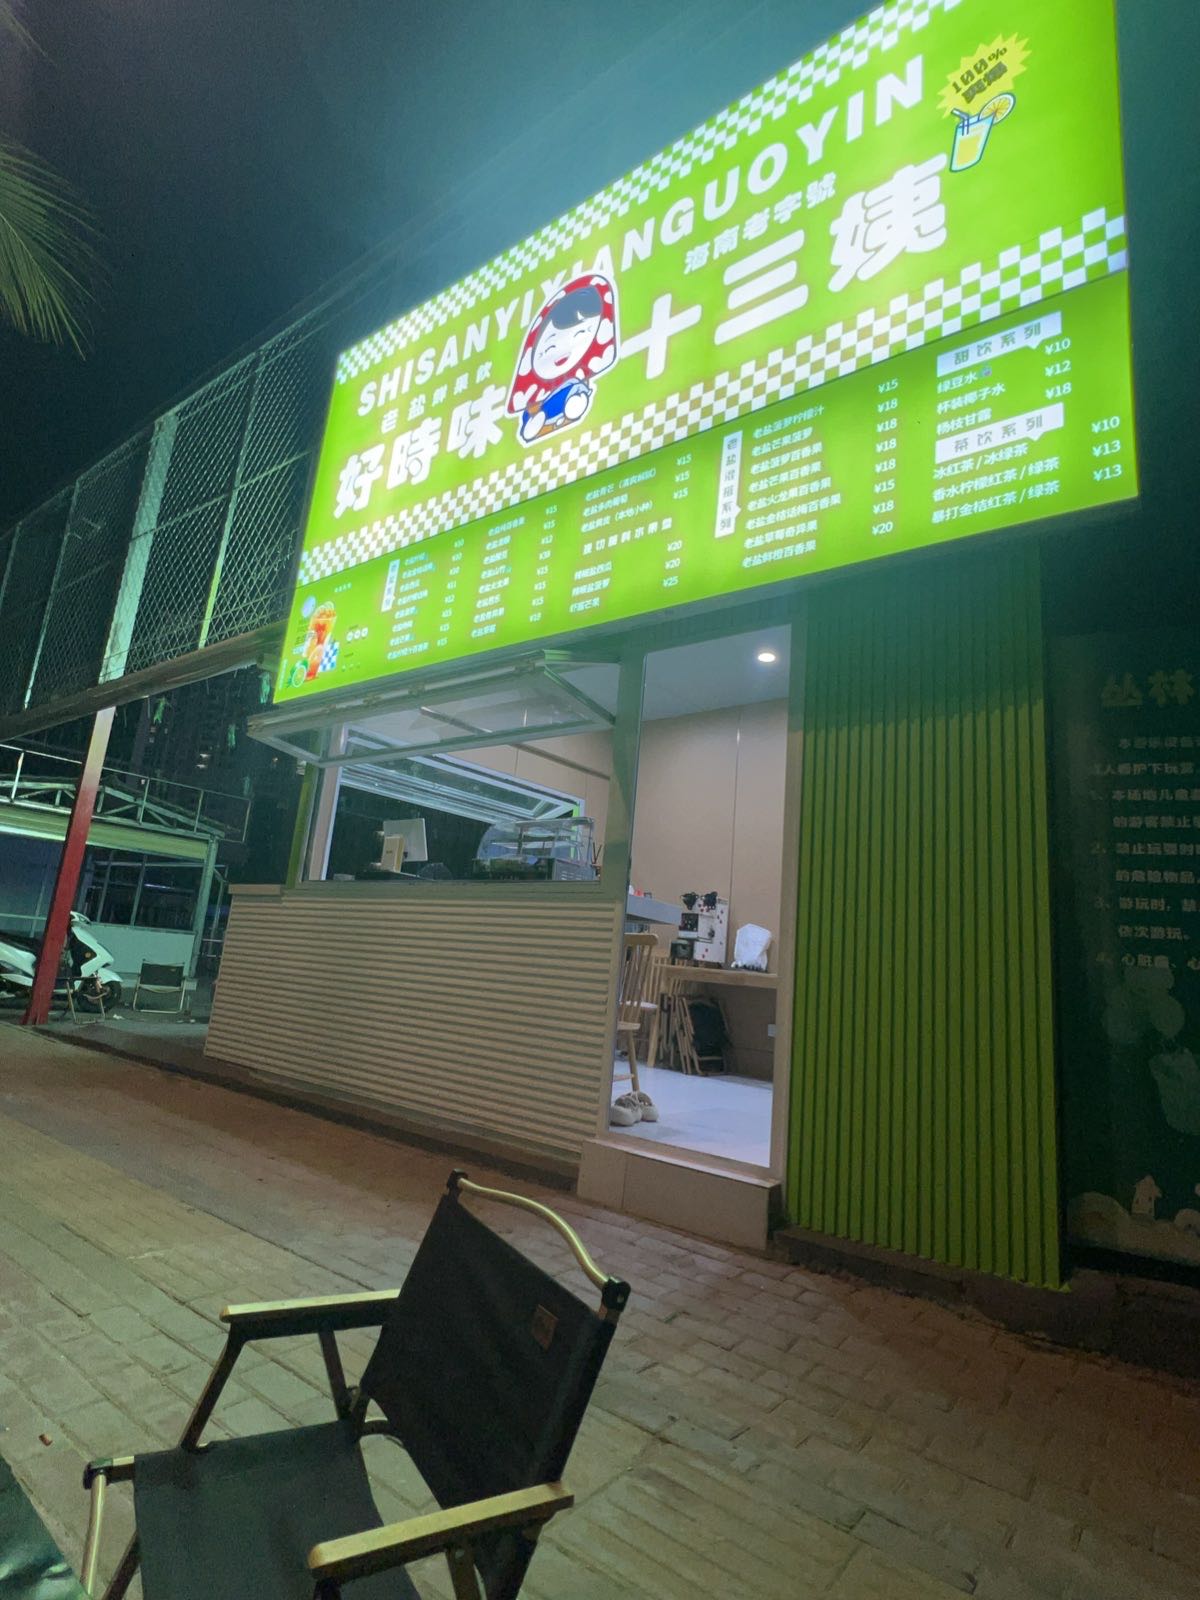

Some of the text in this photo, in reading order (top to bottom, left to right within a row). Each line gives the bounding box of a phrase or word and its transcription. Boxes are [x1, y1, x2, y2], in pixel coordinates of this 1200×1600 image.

[952, 47, 1007, 93] 100%
[954, 323, 1041, 365] 甜饮系列
[937, 338, 1071, 393] 绿豆水 ¥10
[1045, 360, 1072, 377] ¥12
[878, 379, 899, 393] ¥15
[877, 399, 898, 413] ¥18
[936, 382, 1072, 435] 杨枝甘露 ¥18
[876, 418, 897, 433] ¥18
[1091, 416, 1120, 433] ¥10
[954, 415, 1043, 453] 茶饮系列
[876, 438, 897, 453] ¥18
[1092, 440, 1121, 457] ¥13
[875, 458, 896, 474] ¥18
[1093, 464, 1122, 482] ¥13
[874, 479, 895, 494] ¥15
[873, 500, 894, 514] ¥18
[872, 521, 893, 536] ¥20
